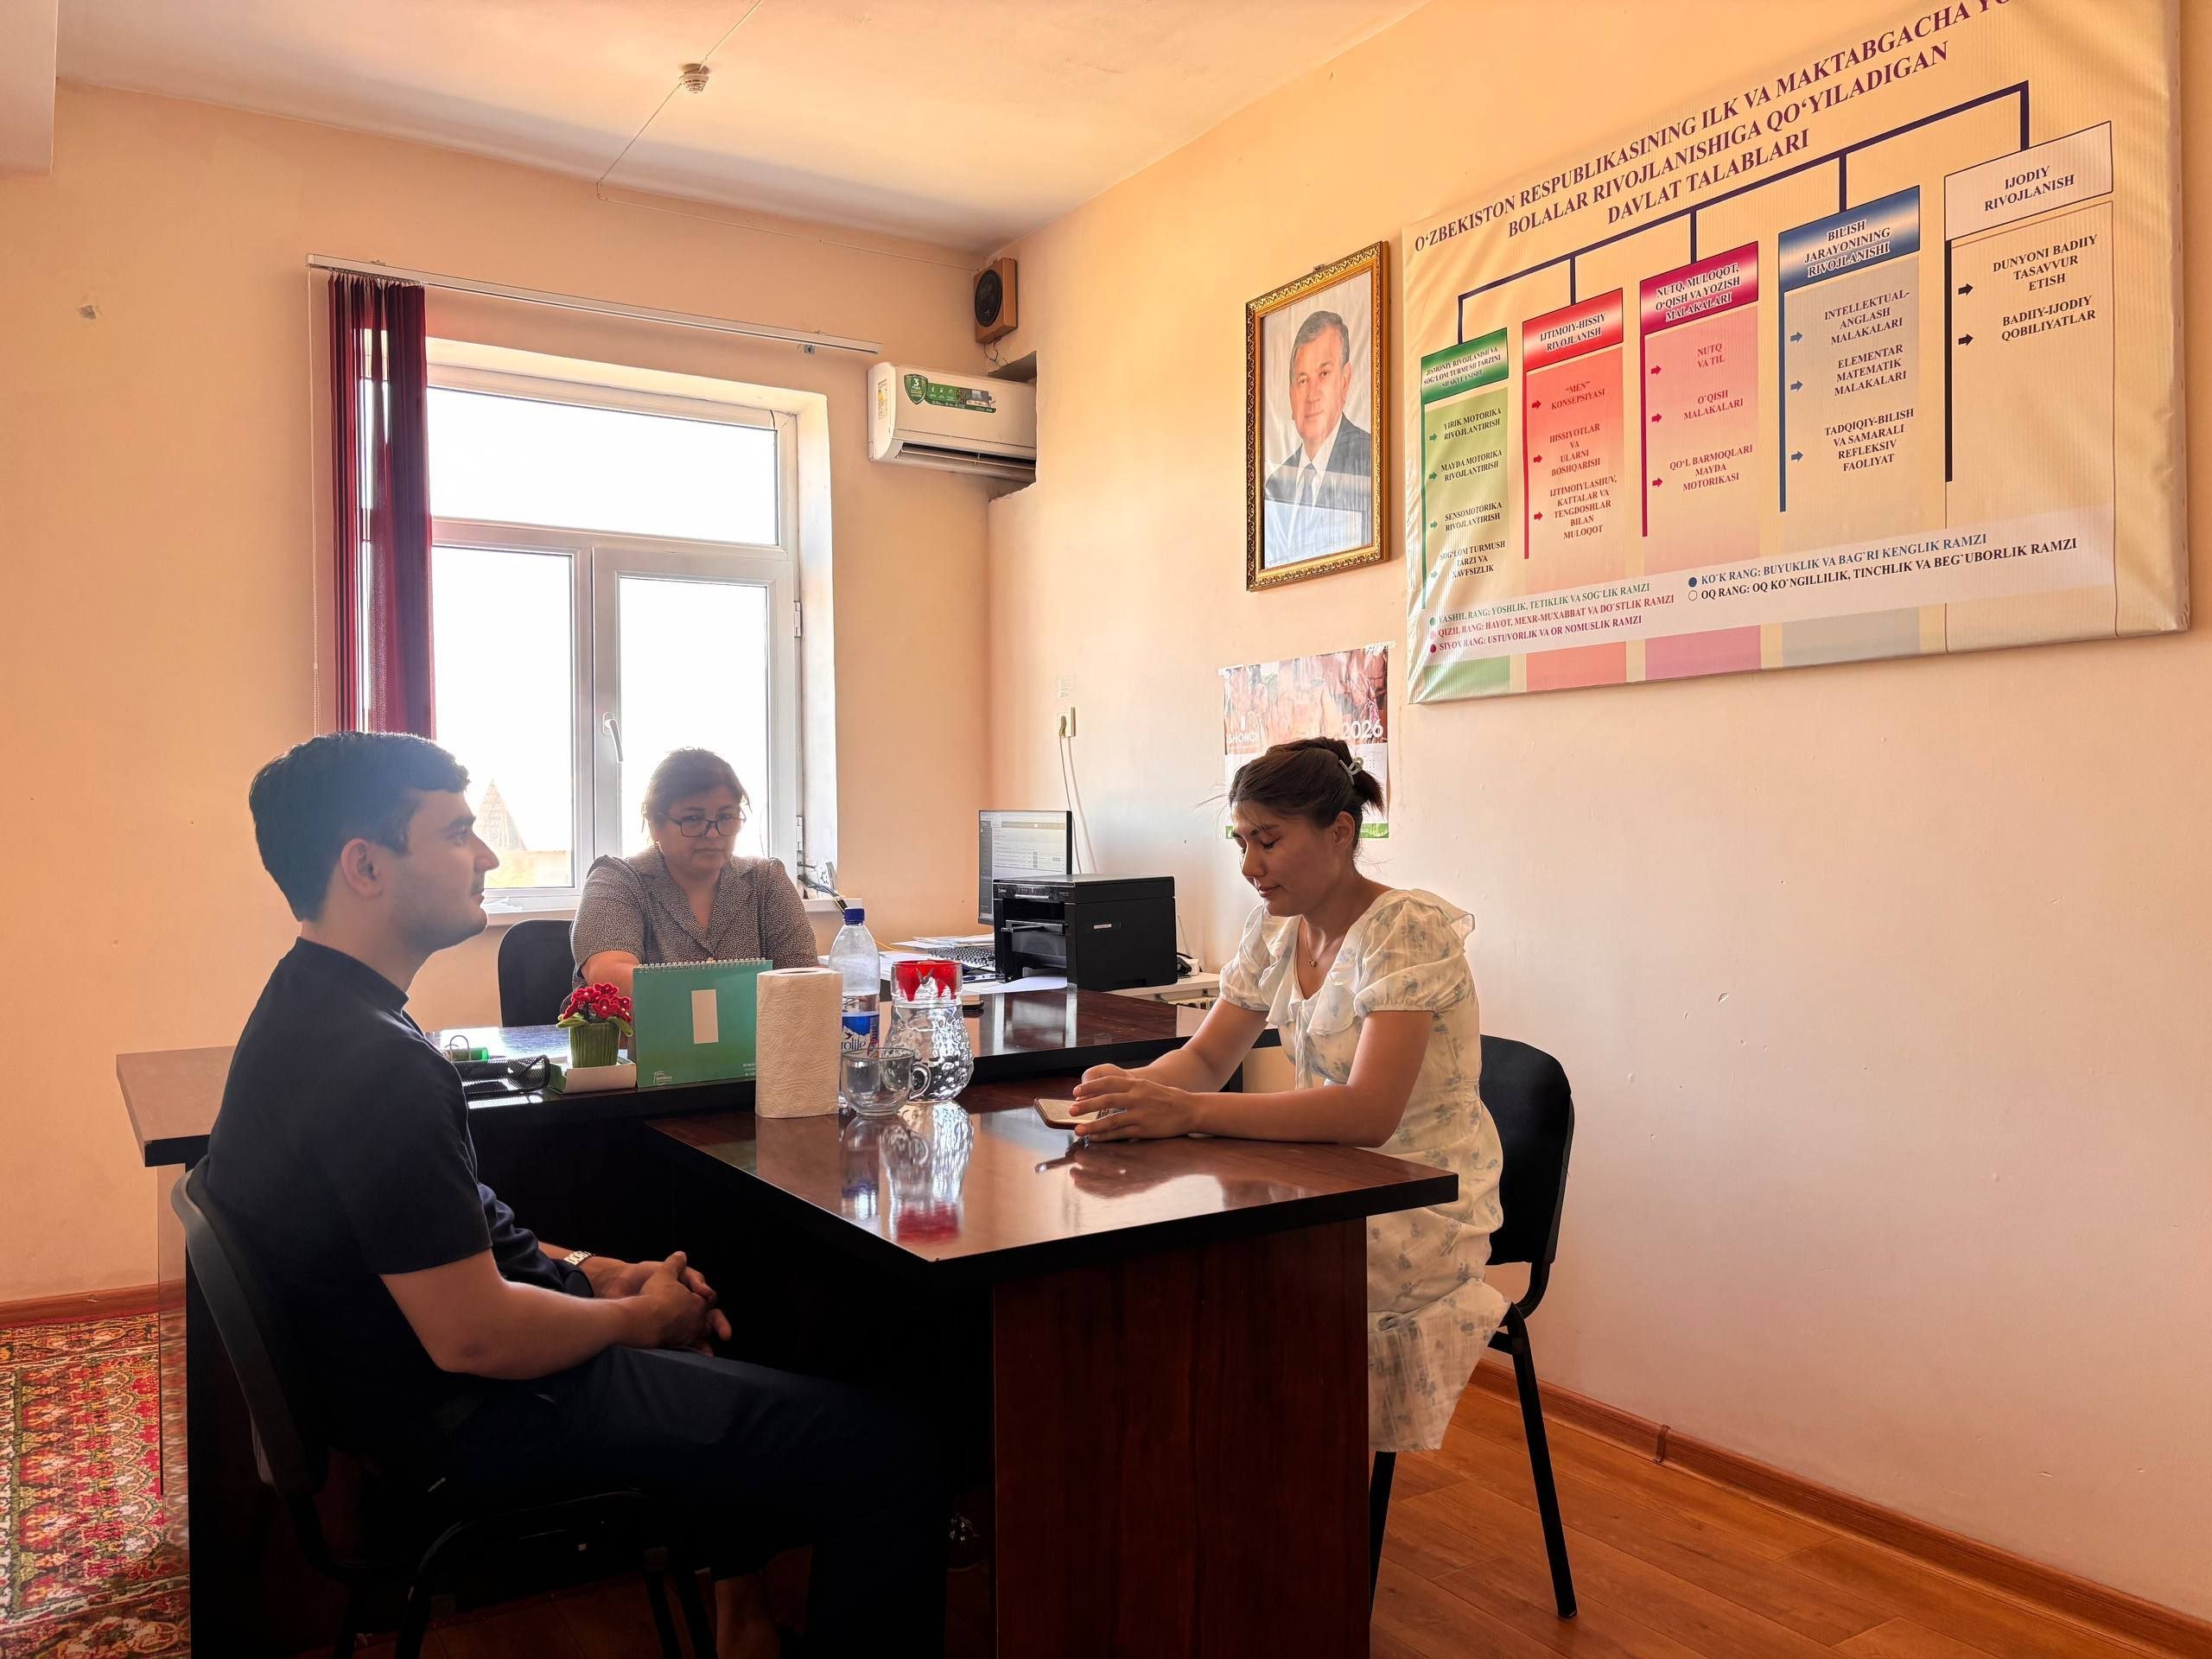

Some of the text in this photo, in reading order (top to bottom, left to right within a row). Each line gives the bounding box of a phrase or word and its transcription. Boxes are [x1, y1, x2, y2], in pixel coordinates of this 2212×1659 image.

[1520, 118, 1696, 207] RESPUBLIKASINING
[1701, 97, 1738, 130] ILK
[1744, 86, 1771, 109] VA
[1776, 2, 1971, 98] MAKTABGACHA
[1508, 193, 1588, 238] BOLALAR
[1592, 120, 1762, 204] RIVOJLANISHIGA
[1608, 128, 1809, 225] DAVLAT TALABLARI
[2005, 166, 2050, 189] IJODIY
[1984, 175, 2075, 212] RIVOJLANISH
[1827, 220, 1866, 241] BILISH
[1804, 227, 1891, 264] JARAYONINING
[1993, 234, 2098, 272] DUNYONI BADIIY
[1808, 243, 1890, 276] RIVOJLANISHI
[2013, 255, 2079, 280] TASAVVUR
[1656, 264, 1739, 298] NUTQ, MULOQOT,
[1689, 290, 1702, 299] VA
[1703, 276, 1740, 296] YOZISH
[2029, 273, 2066, 291] ETISH
[1666, 293, 1732, 321] MALAKALARI
[1824, 290, 1910, 321] INTELLEKTUAL-
[2002, 295, 2092, 327] BADIIY-IJODIY
[1540, 313, 1605, 341] IJTIMOIY-HISSIY
[1840, 308, 1891, 329] ANGLASH
[2001, 309, 2096, 341] QOBILIYATLAR
[1547, 327, 1601, 352] RIVOJLANISH
[1831, 317, 1903, 345] MALAKALARI
[1697, 343, 1722, 357] NUTQ
[1838, 344, 1904, 369] ELEMENTAR
[1697, 355, 1725, 369] VA TIL
[1836, 358, 1902, 383] MATEMATIK
[1834, 370, 1907, 396] MALAKALARI
[1551, 388, 1605, 410] KONSEPSIYASI
[1683, 398, 1744, 421] MALAKALARI
[1444, 408, 1502, 430] YIRIK MOTORIKA
[1444, 418, 1501, 441] RIVOJLANTIRISH
[1824, 408, 1914, 436] TADQIQIY-BILISH
[1549, 423, 1600, 443] HISSIYOTLAR
[1834, 423, 1904, 447] VA SAMARALI
[1440, 449, 1502, 473] MAYDA MOTORIKA
[1560, 449, 1589, 462] ULARNI
[1692, 444, 1753, 465] BARMOQLARI
[1838, 439, 1897, 460] REFLEKSIV
[1444, 461, 1499, 482] RIVOJLANTIRISH
[1551, 458, 1600, 476] BOSHQARISH
[1695, 463, 1726, 476] MAYDA
[1843, 454, 1895, 472] FAOLIYAT
[1550, 475, 1618, 497] IJTIMOIYLASHUV,
[1682, 472, 1740, 492] MOTORIKASI
[1554, 499, 1611, 518] TENGDOSHLAR
[1557, 491, 1598, 507] KATTALAR
[1445, 502, 1502, 522] SENSOMOTORIKA
[1446, 512, 1501, 531] RIVOJLANTIRISH
[1570, 514, 1594, 527] BILAN
[1563, 524, 1604, 540] MULOQOT
[1469, 540, 1505, 555] TURMUSH
[1729, 568, 1761, 581] RANG:
[1764, 558, 1820, 575] BUYUKLIK
[1821, 556, 1836, 567] VA
[1882, 540, 1940, 559] KENGLIK
[1943, 534, 1986, 550] RAMZI
[1701, 588, 1716, 601] OQ
[1719, 584, 1750, 597] RANG:
[1752, 582, 1768, 594] OQ
[1853, 561, 1913, 580] TINCHLIK
[1916, 559, 1931, 570] VA
[2031, 538, 2076, 555] RAMZI
[1468, 608, 1491, 620] RANG:
[1491, 602, 1529, 615] YOSHLIK,
[1529, 595, 1569, 609] TETIKLIK
[1570, 594, 1580, 602] VA
[1620, 582, 1649, 595] RAMZI
[1438, 626, 1460, 638] QIZIL
[1462, 623, 1484, 633] RANG:
[1485, 619, 1513, 630] HAYOT,
[1515, 607, 1586, 626] MEXR-MUXABBAT
[1587, 606, 1599, 614] VA
[1643, 594, 1675, 607] RAMZI
[1487, 630, 1537, 644] USTUVORLIK
[1539, 628, 1549, 637] VA
[1550, 626, 1562, 635] OR
[1564, 620, 1611, 633] NOMUSLIK
[1612, 615, 1642, 627] RAMZI
[1342, 719, 1383, 741] 2026
[842, 1038, 866, 1050] rolife
